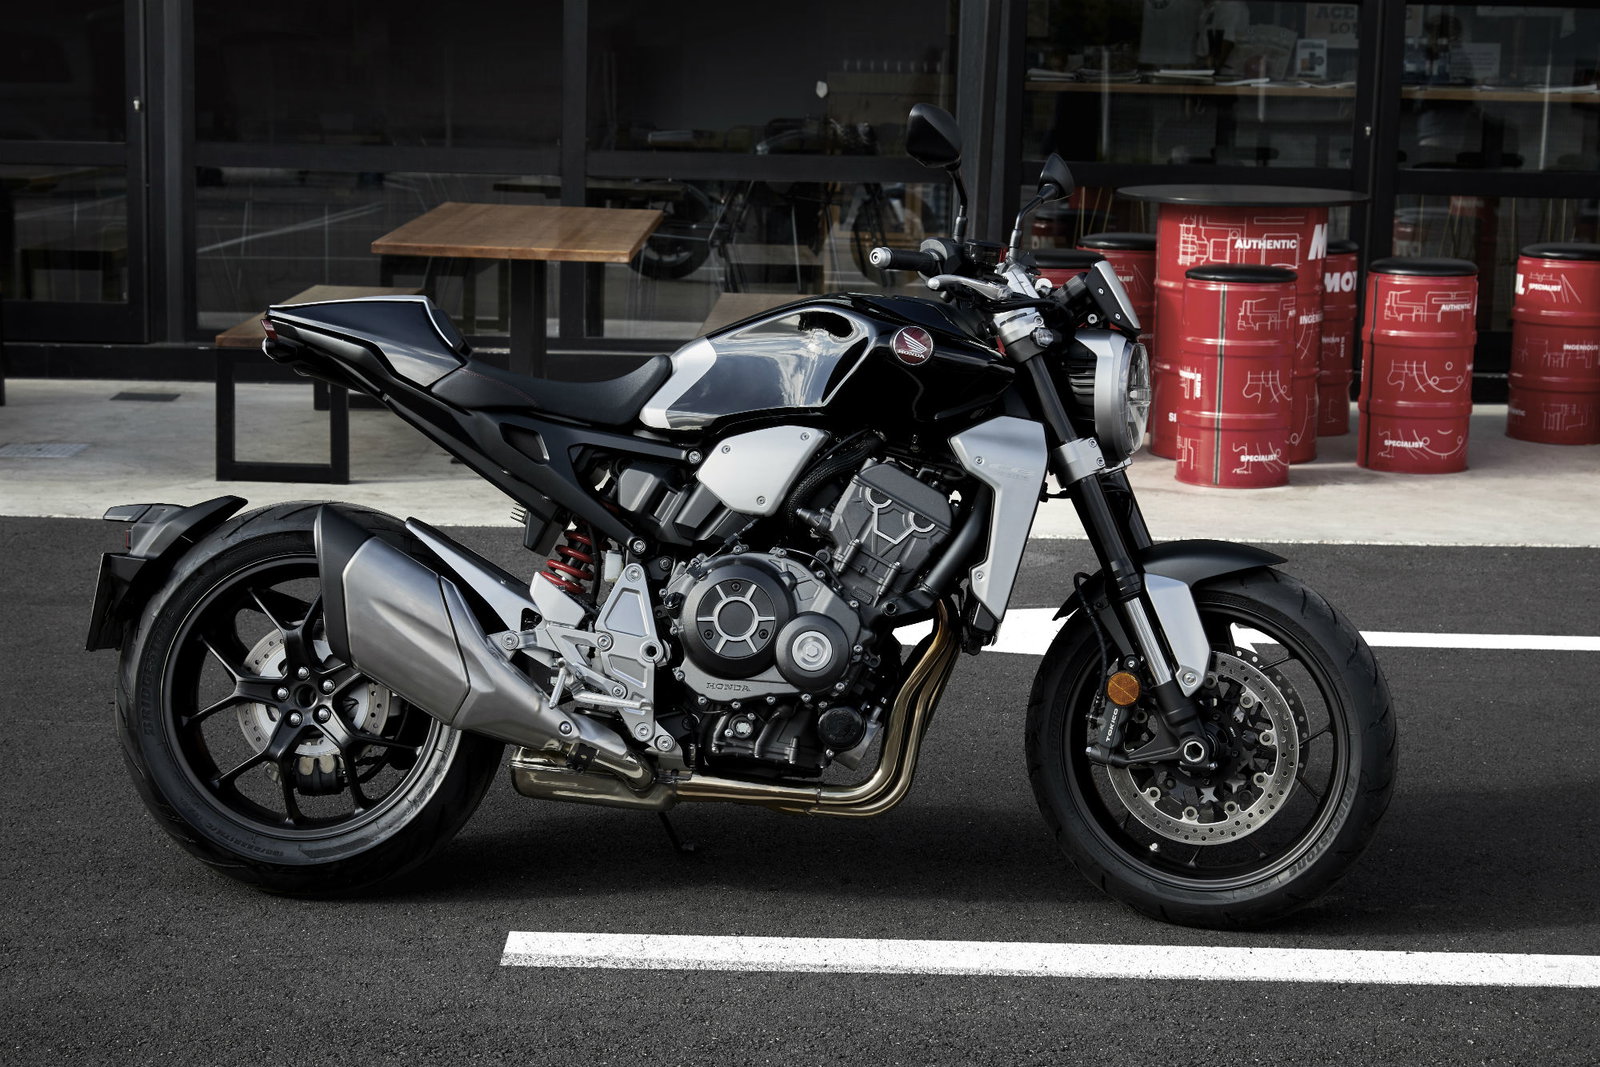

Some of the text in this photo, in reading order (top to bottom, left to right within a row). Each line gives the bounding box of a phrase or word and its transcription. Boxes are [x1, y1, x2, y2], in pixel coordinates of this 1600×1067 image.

[1234, 238, 1297, 250] AUTHENTIC
[1440, 302, 1473, 311] AUTHENTIC
[897, 348, 926, 359] HONDA
[1384, 439, 1424, 448] SPECIALIST
[1240, 454, 1277, 462] SPECIALIST
[706, 681, 752, 692] HONDA
[1105, 708, 1119, 743] TOKICO
[1287, 776, 1356, 877] BRIDGESTONE
